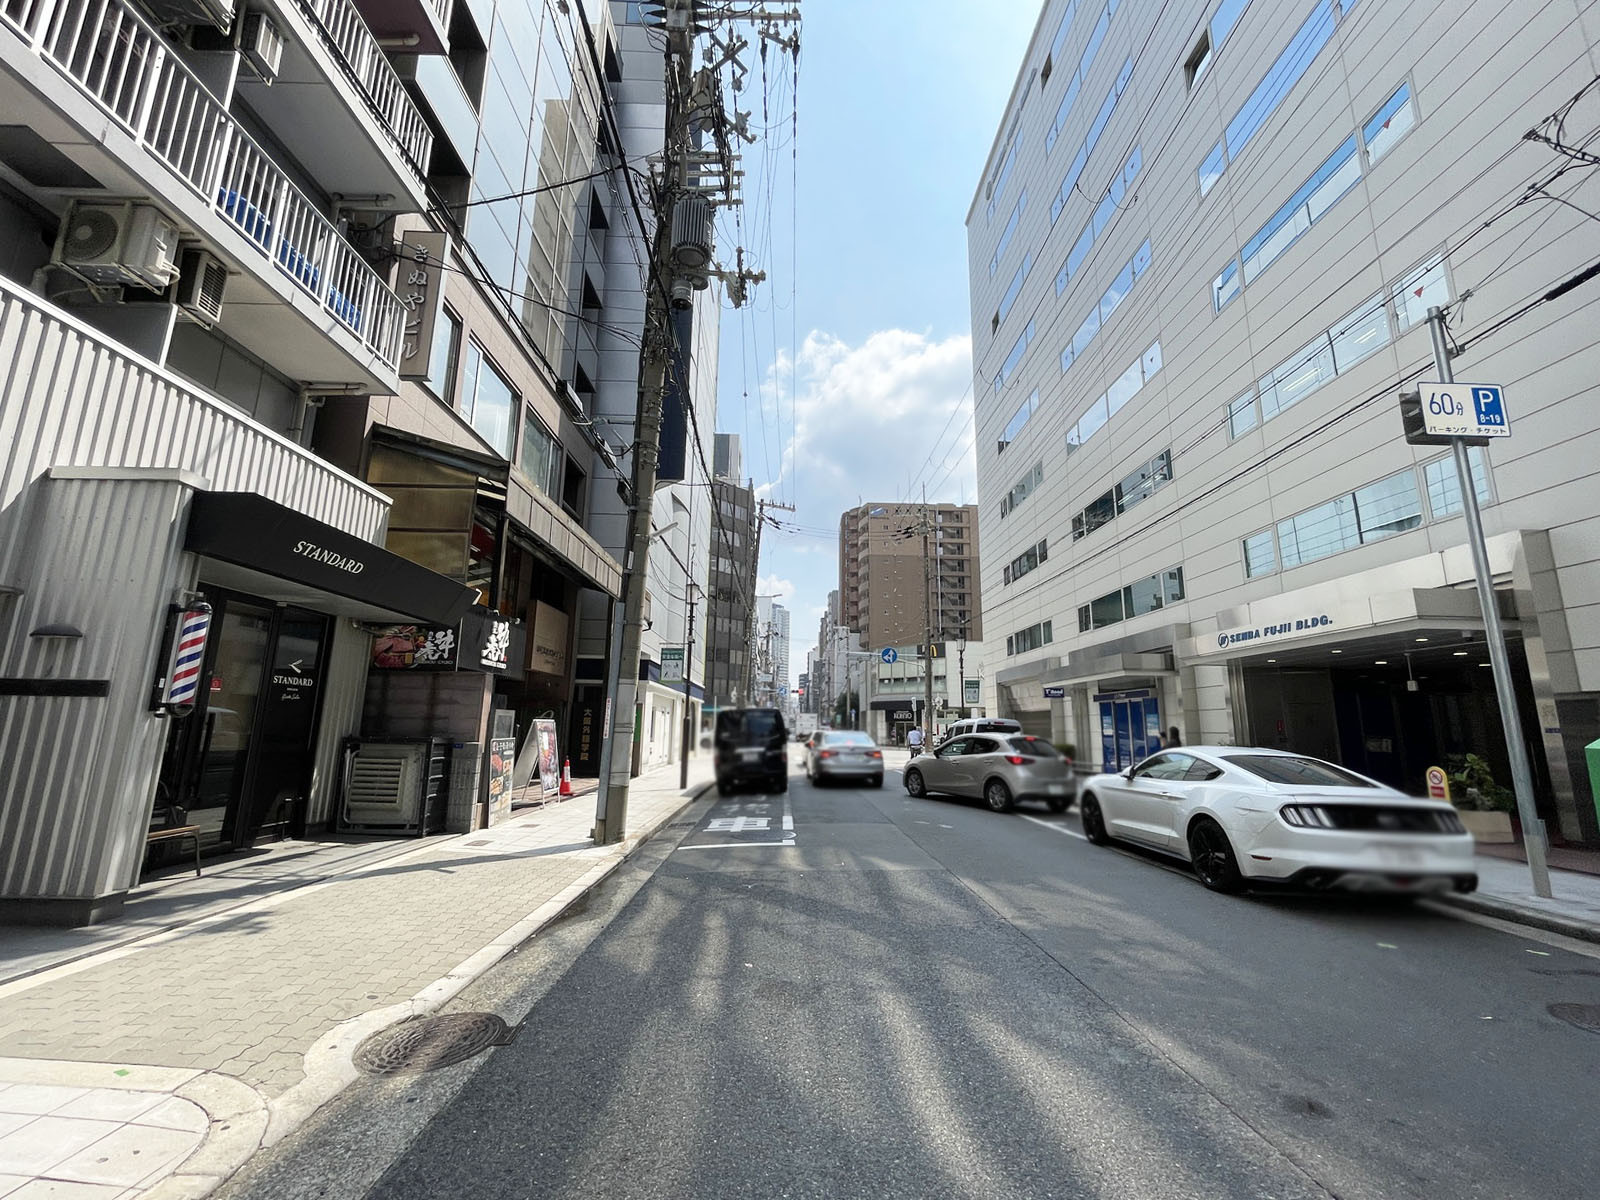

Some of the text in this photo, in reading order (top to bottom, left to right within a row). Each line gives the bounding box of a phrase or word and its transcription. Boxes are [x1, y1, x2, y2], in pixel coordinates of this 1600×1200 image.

[1429, 391, 1464, 416] 60分
[1478, 389, 1494, 412] P
[1479, 413, 1502, 424] 8-19
[293, 540, 365, 575] STANDARD
[1263, 622, 1292, 637] FUJII
[1295, 614, 1333, 631] BLDG.
[273, 675, 314, 687] STANDARD
[702, 816, 772, 833] 車
